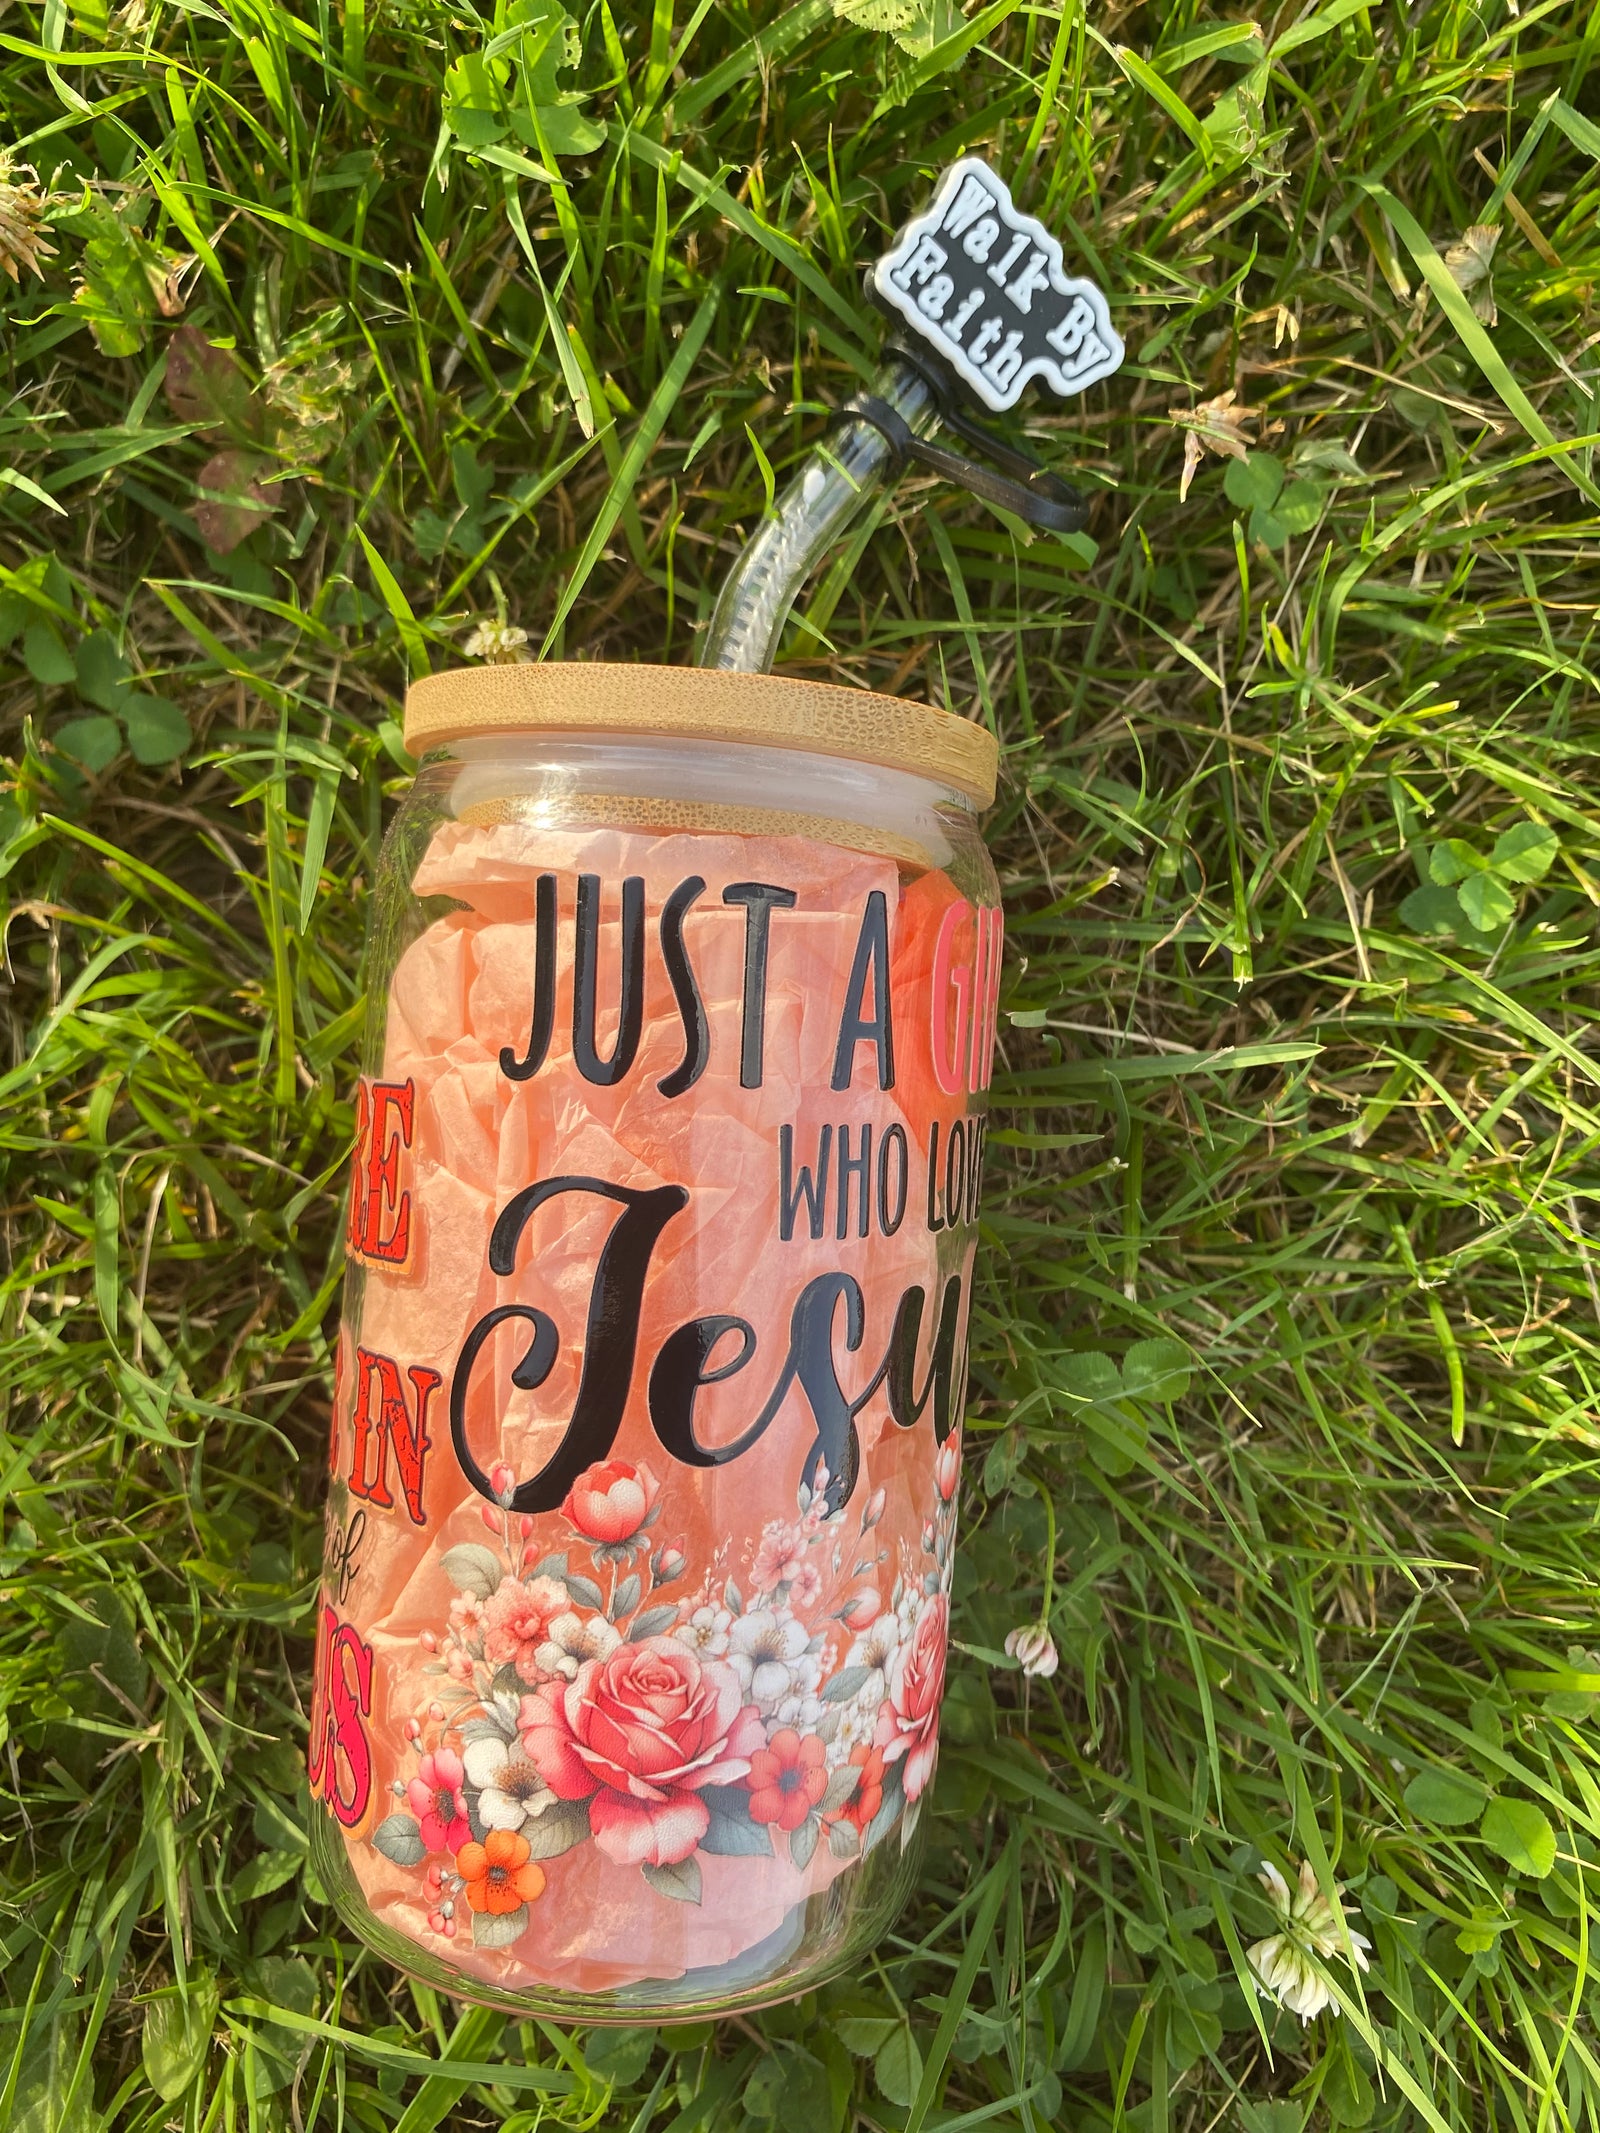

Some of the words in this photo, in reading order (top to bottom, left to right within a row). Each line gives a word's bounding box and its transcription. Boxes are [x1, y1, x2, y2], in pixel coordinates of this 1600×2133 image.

[891, 234, 1024, 393] Faith
[942, 174, 1050, 315] Walk
[1045, 296, 1111, 379] By
[499, 873, 798, 1099] JUST
[830, 890, 896, 1092] A
[778, 1122, 909, 1242] WHO
